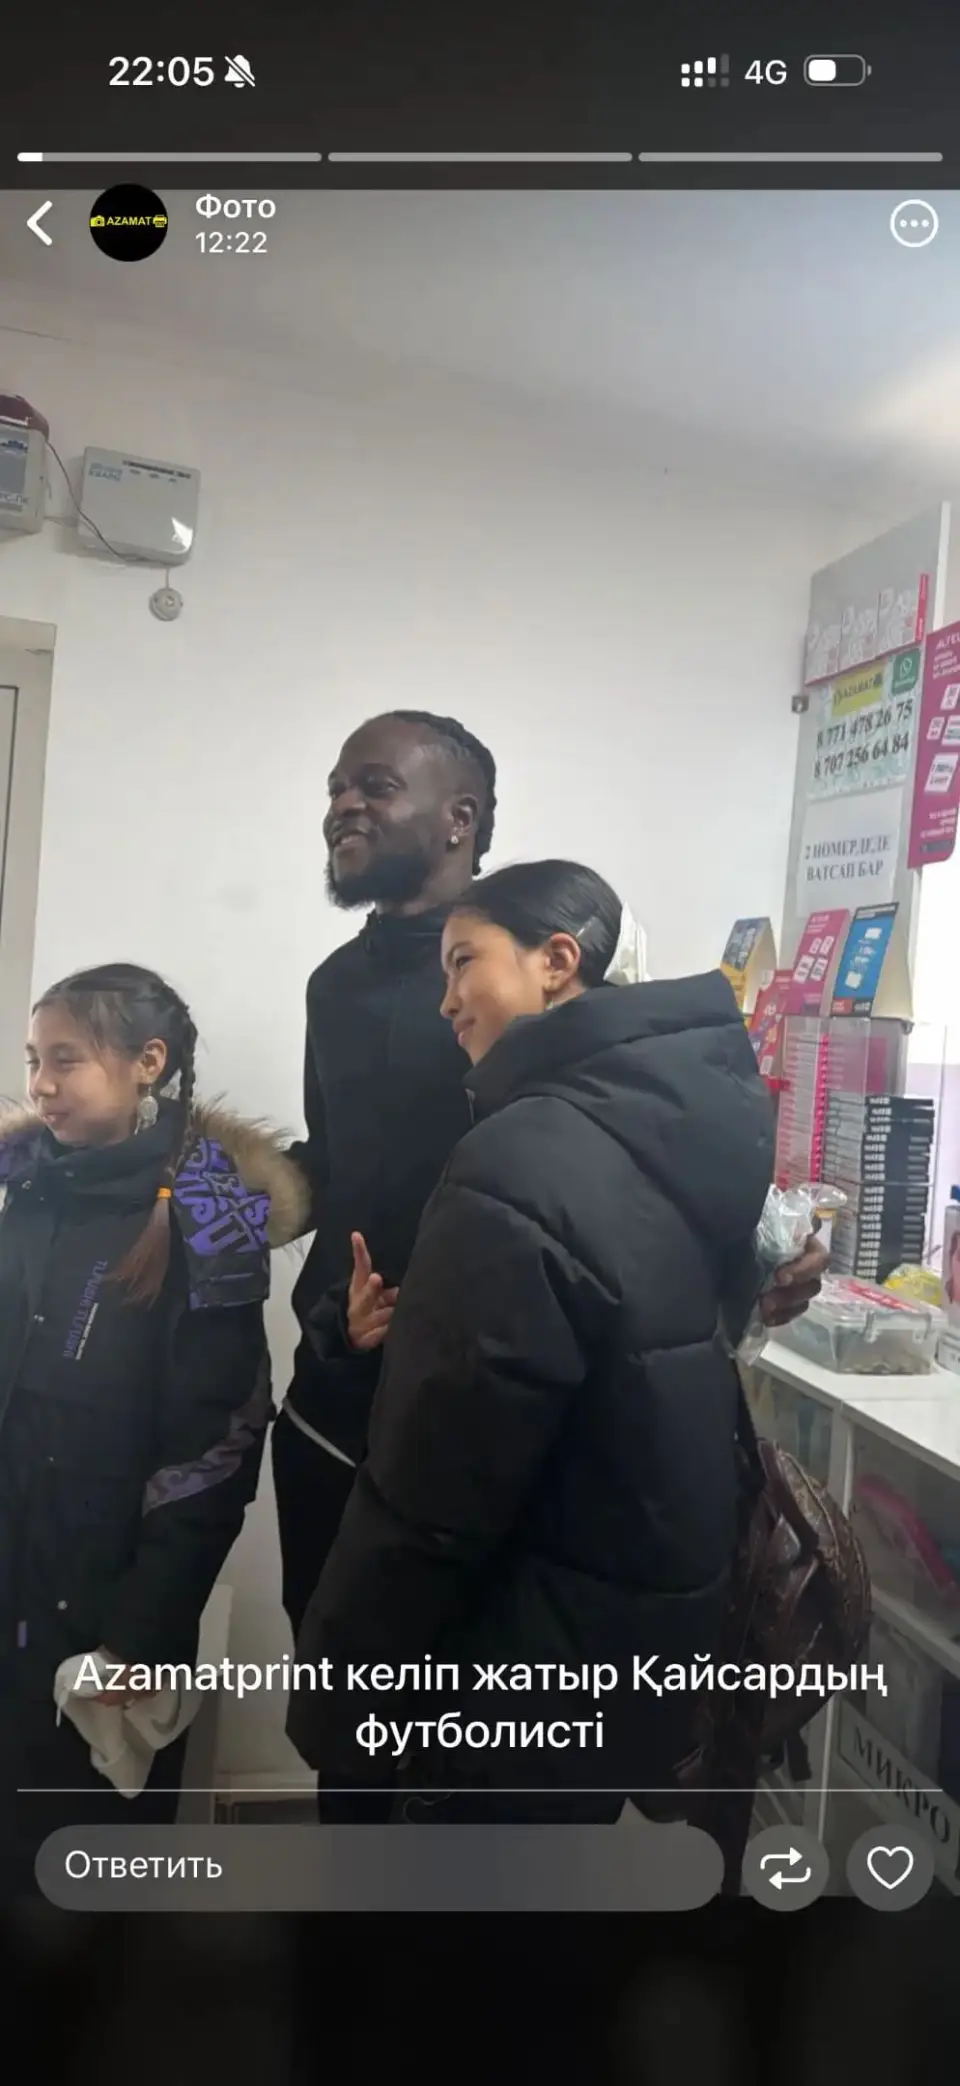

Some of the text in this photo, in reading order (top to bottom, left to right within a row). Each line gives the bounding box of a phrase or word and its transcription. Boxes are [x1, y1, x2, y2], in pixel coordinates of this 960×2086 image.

[816, 698, 914, 749] 8 771 478 26 75
[813, 732, 910, 779] 8 707 256 64 84
[806, 859, 884, 882] ВАТСАП БАР
[853, 1726, 952, 1845] МИКРО
